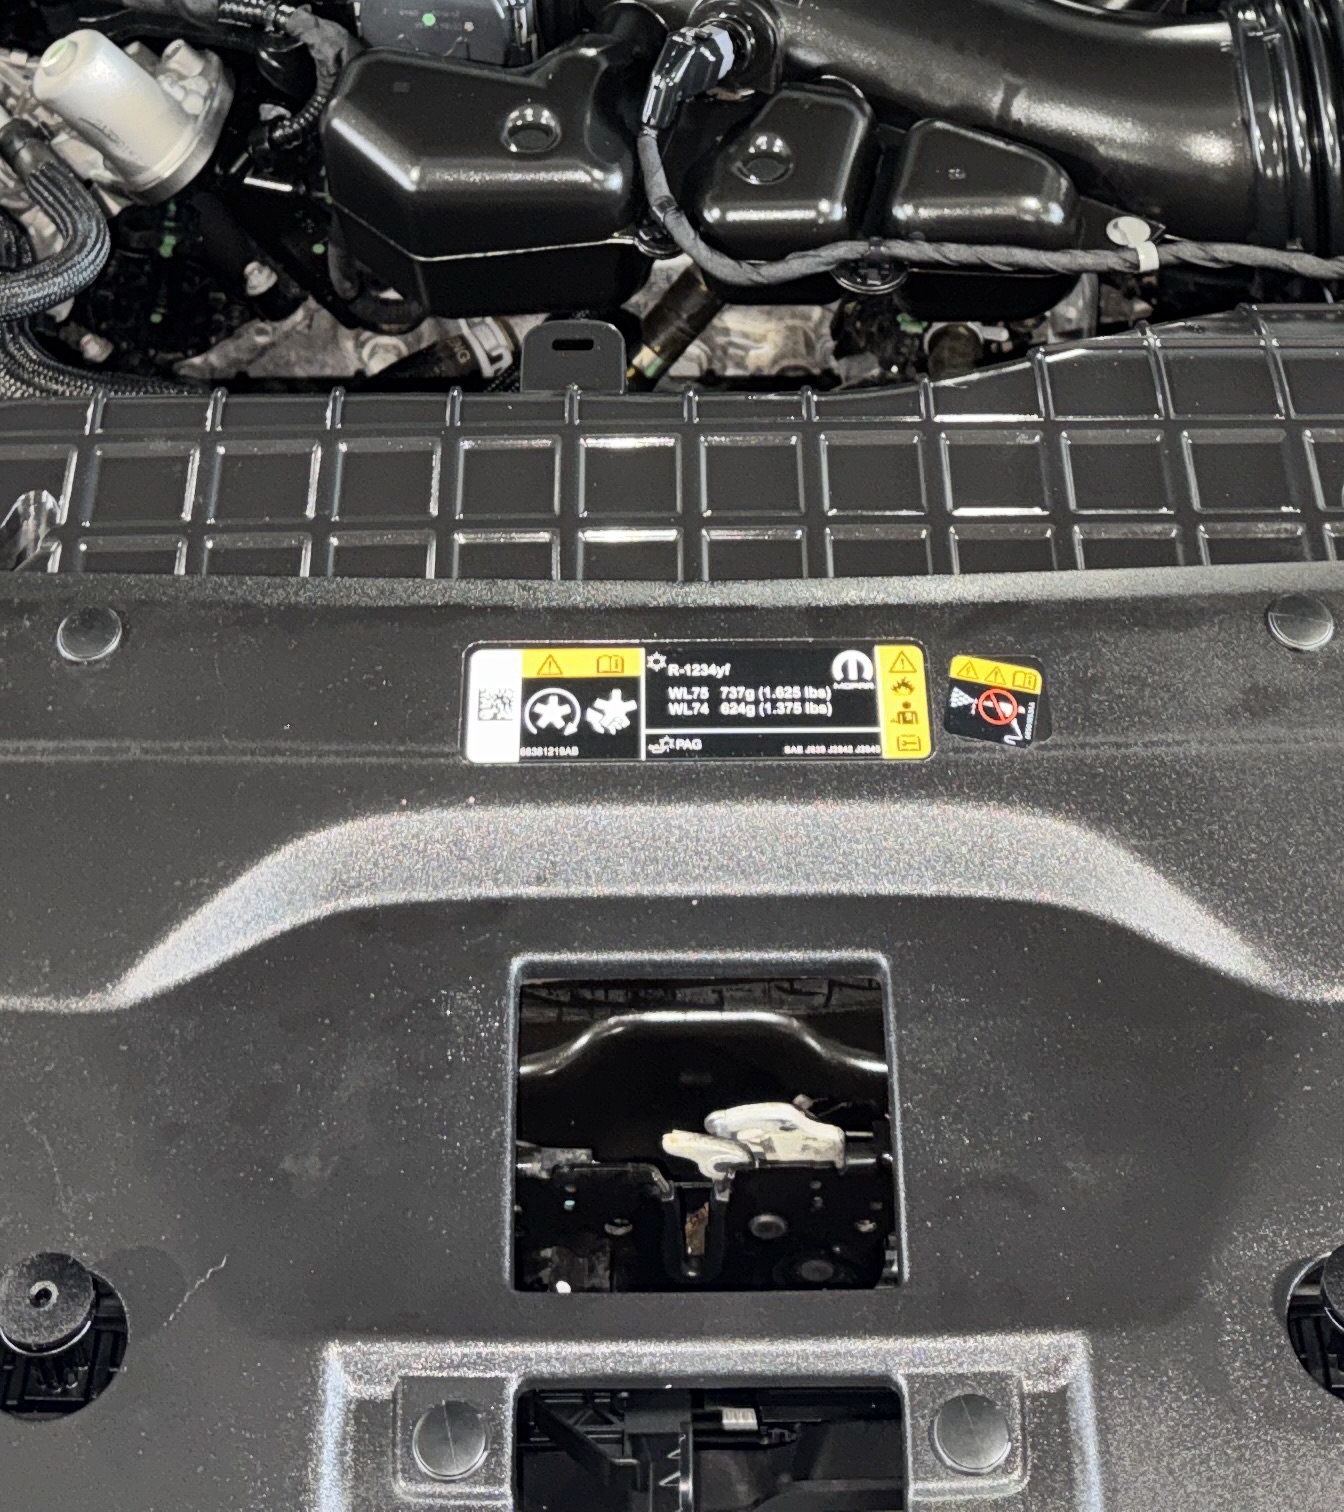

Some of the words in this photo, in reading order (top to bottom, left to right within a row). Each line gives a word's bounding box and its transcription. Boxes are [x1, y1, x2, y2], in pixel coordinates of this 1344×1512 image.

[668, 662, 731, 679] R-1234yf
[668, 686, 709, 700] WL75
[720, 685, 756, 702] 737g
[758, 685, 802, 702] (1.625
[803, 685, 832, 702] lbs)
[668, 701, 709, 716] WL74
[720, 701, 756, 718] 624g
[759, 701, 803, 718] (1.375
[804, 701, 833, 718] lbs)
[675, 738, 703, 751] PAG
